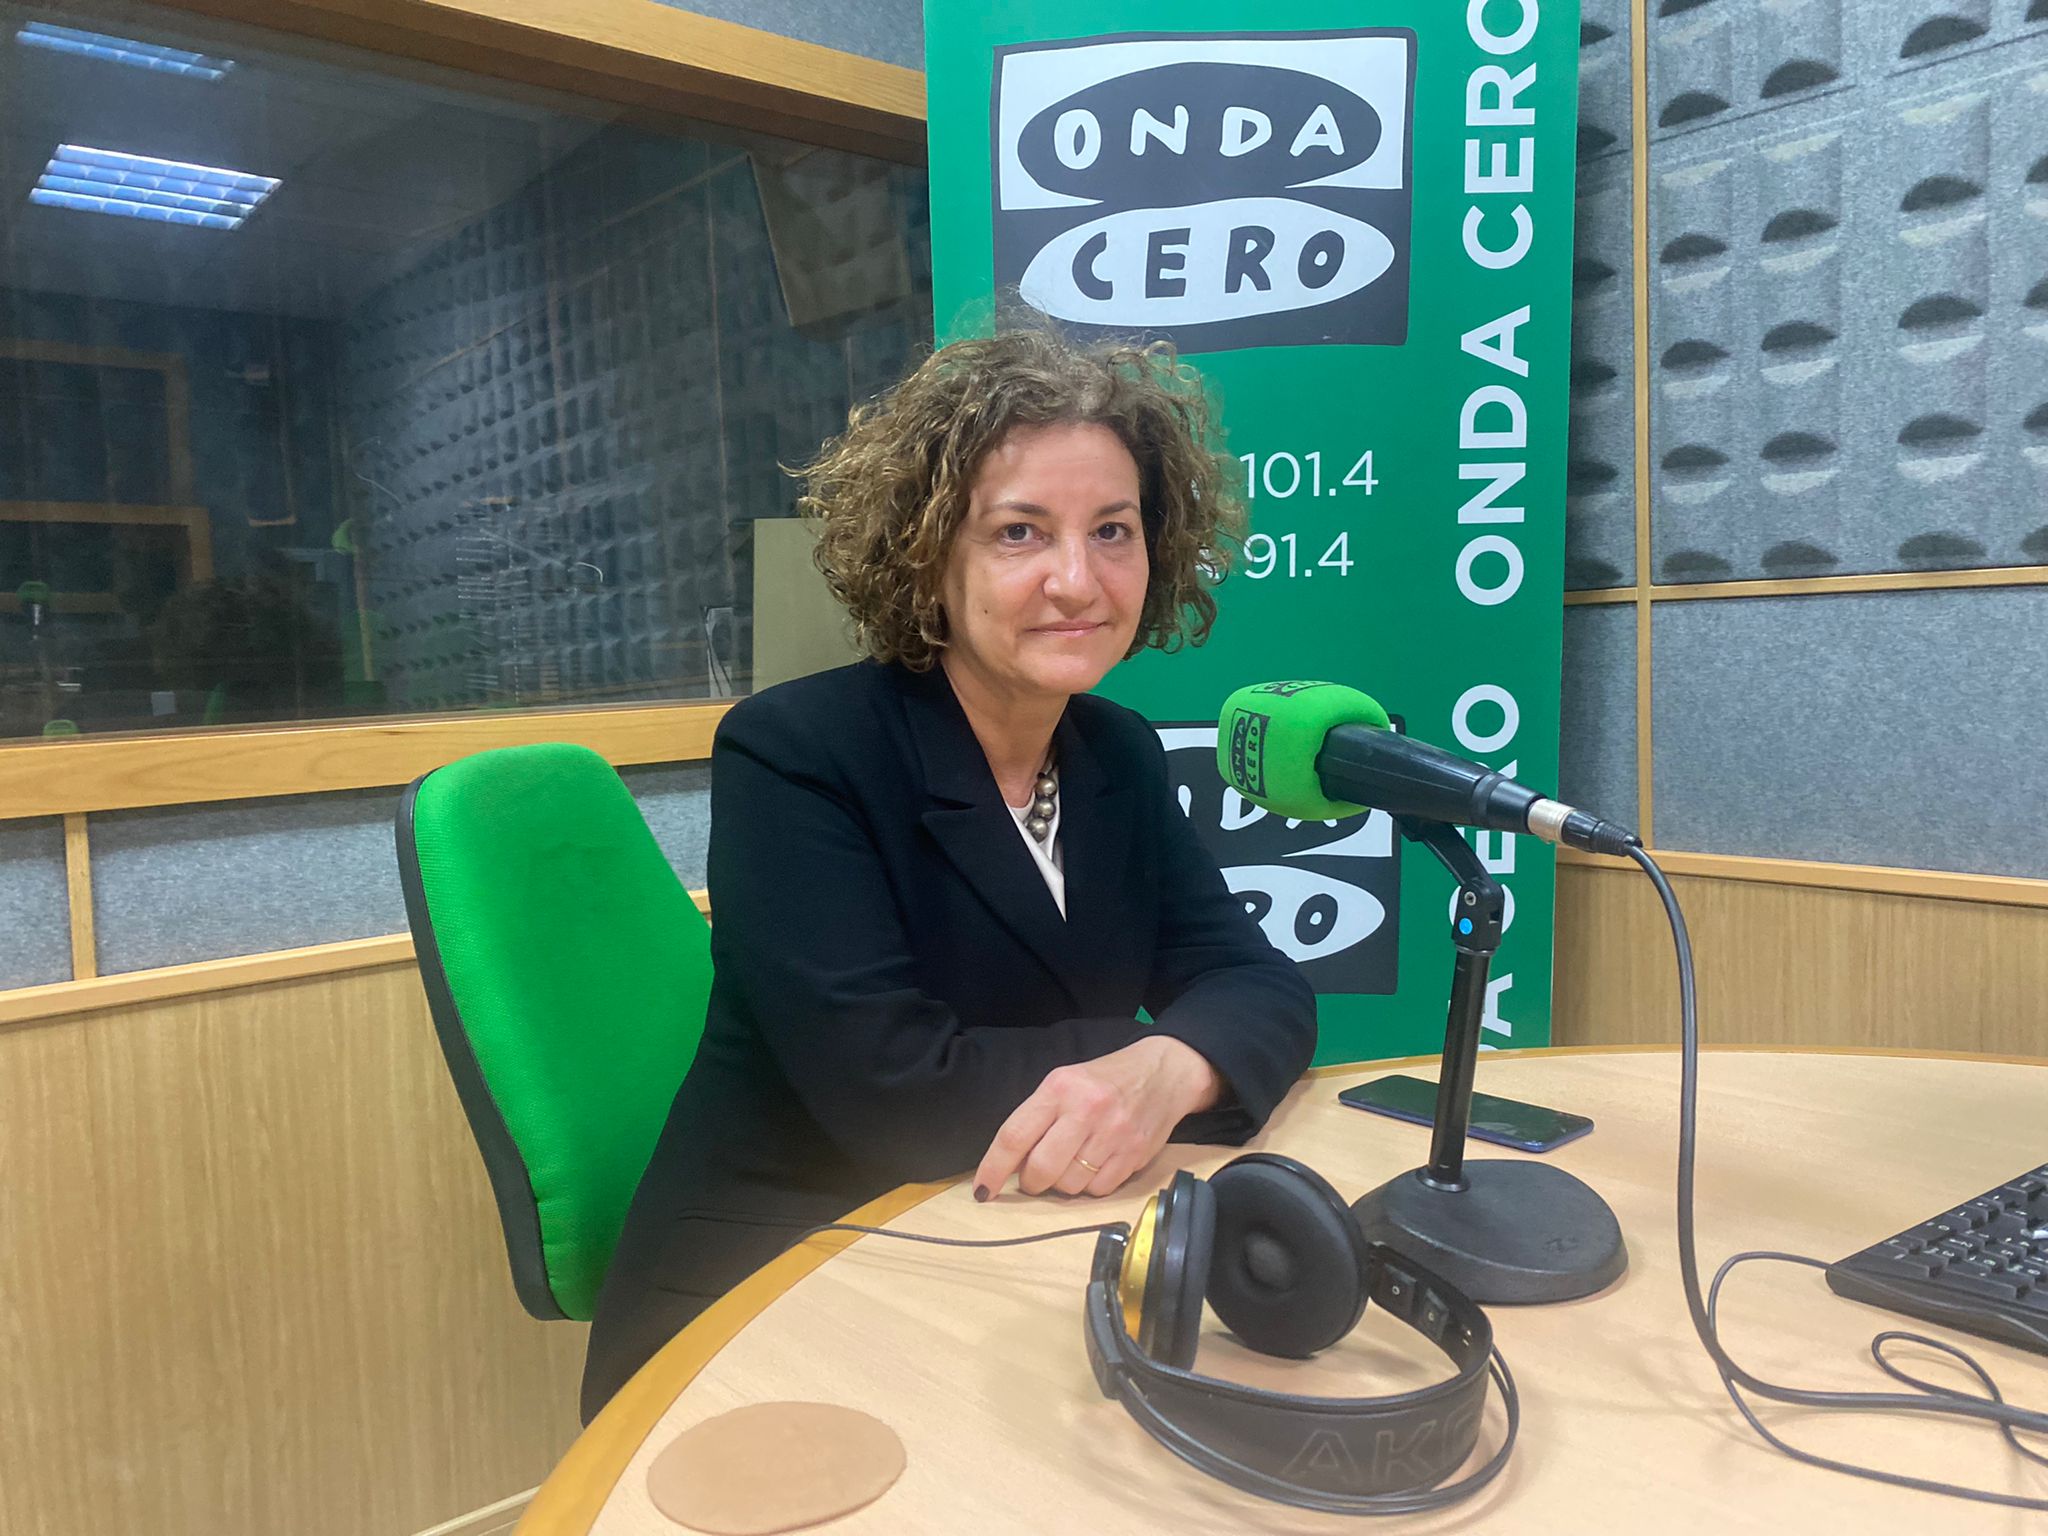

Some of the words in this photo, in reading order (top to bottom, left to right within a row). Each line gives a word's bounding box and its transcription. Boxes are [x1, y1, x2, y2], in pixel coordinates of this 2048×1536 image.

[1054, 104, 1345, 170] ONDA
[1462, 0, 1539, 269] CERO
[1072, 225, 1345, 300] CERO
[1239, 450, 1379, 498] 101.4
[1455, 304, 1531, 606] ONDA
[1243, 532, 1354, 579] 91.4
[1234, 723, 1245, 781] ONDA
[1246, 726, 1258, 782] CERO
